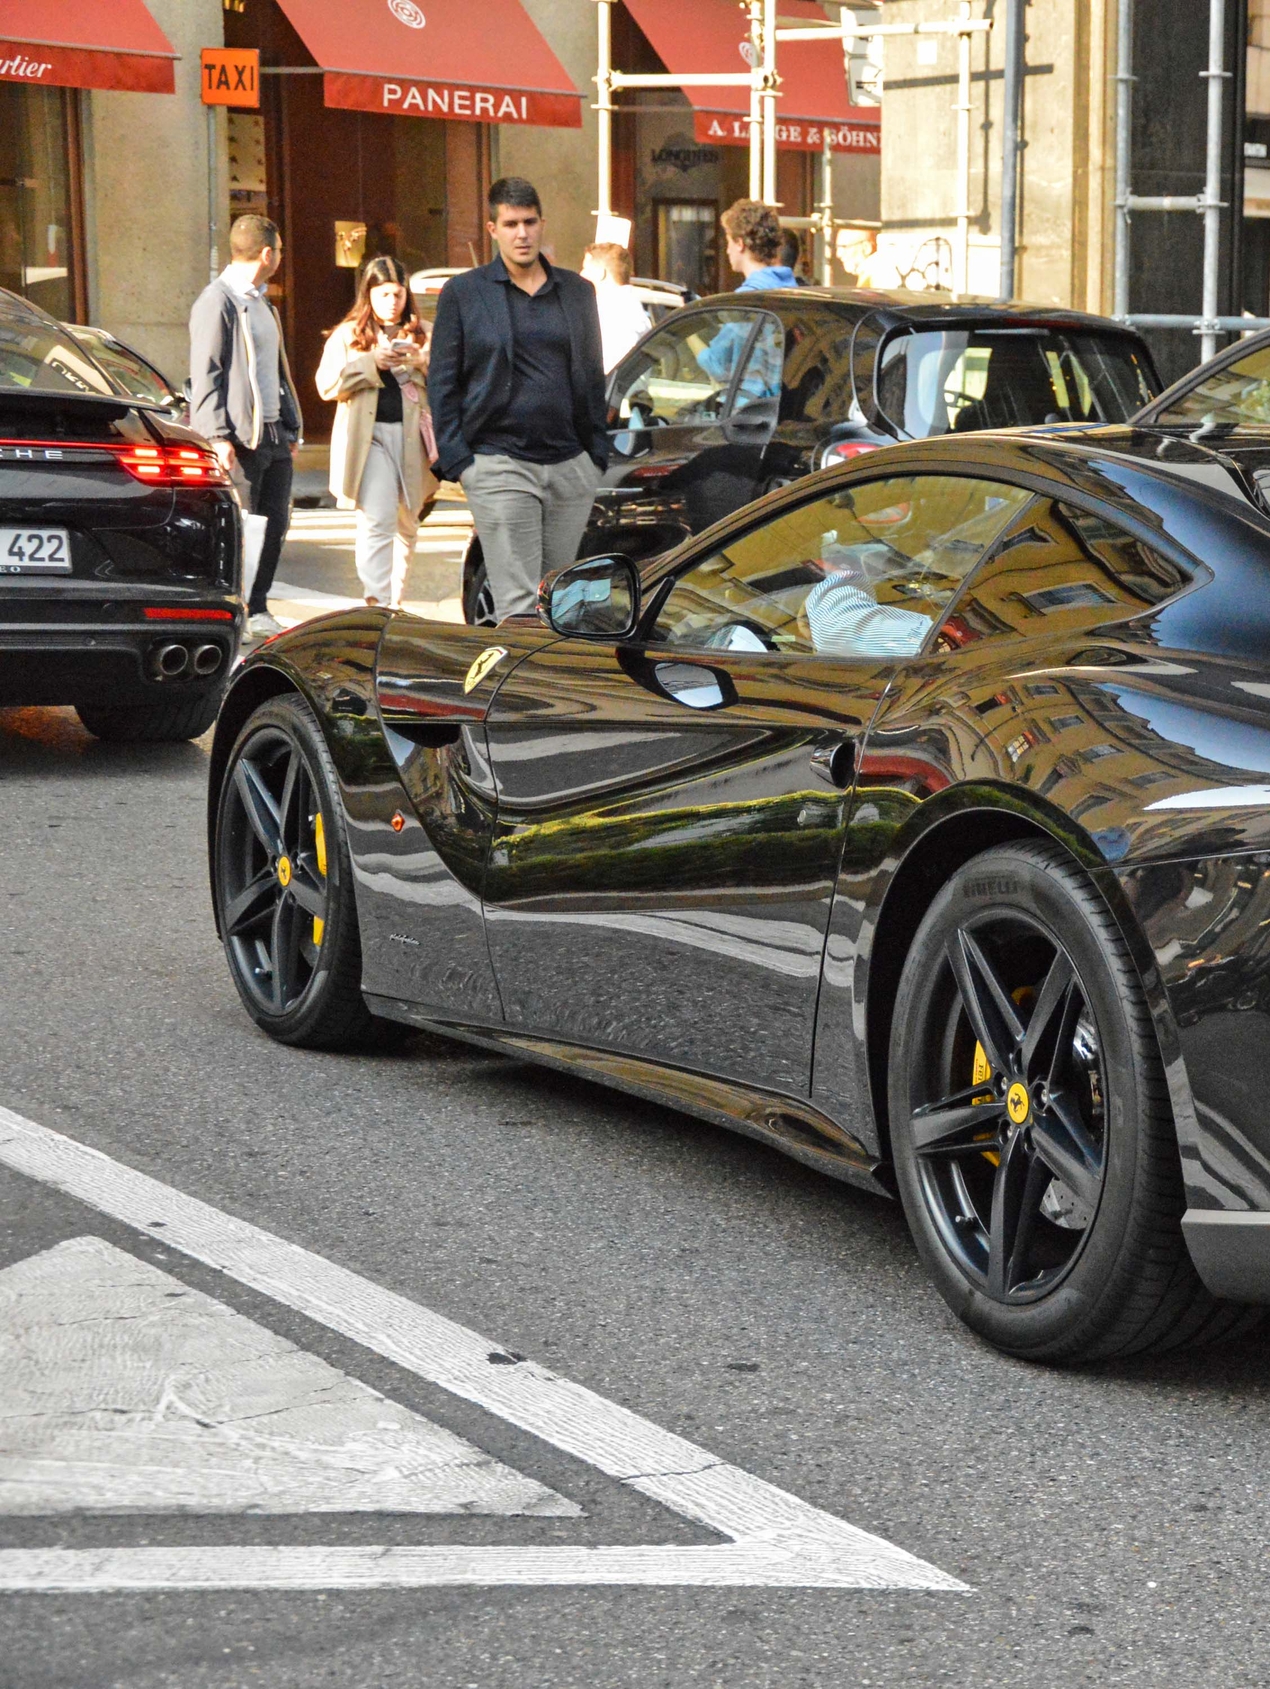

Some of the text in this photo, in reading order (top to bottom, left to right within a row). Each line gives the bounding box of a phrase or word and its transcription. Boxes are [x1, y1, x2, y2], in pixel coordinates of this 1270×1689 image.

[0, 55, 52, 78] rtier
[204, 63, 254, 91] TAXI
[383, 83, 528, 120] PANERAI
[708, 119, 882, 148] A. LGE & SÖHN
[0, 449, 63, 460] HE
[7, 533, 65, 563] 422
